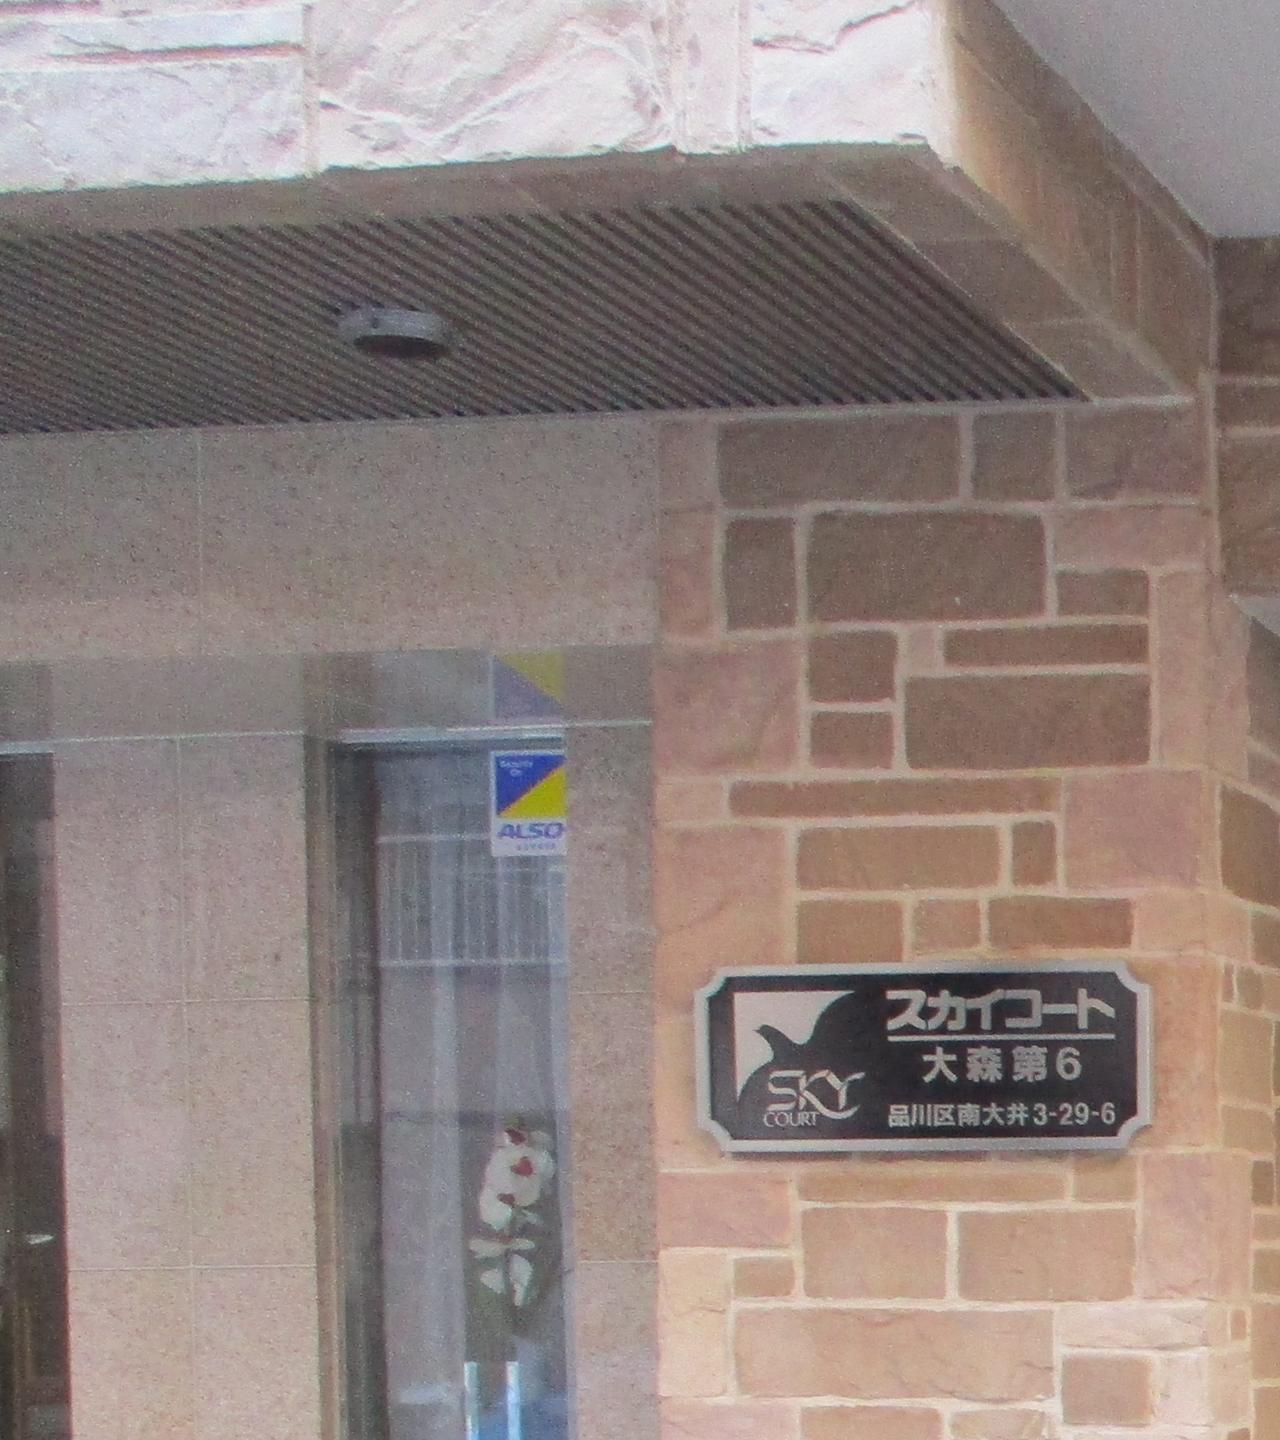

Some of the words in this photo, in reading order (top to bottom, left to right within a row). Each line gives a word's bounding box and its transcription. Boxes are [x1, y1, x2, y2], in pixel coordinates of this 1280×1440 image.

[886, 988, 1115, 1031] スカイコート
[922, 1046, 1082, 1083] 大森第6
[766, 1069, 865, 1119] SKY
[763, 1111, 820, 1128] COURT
[888, 1101, 1116, 1127] 品川区南大井3-29-6
